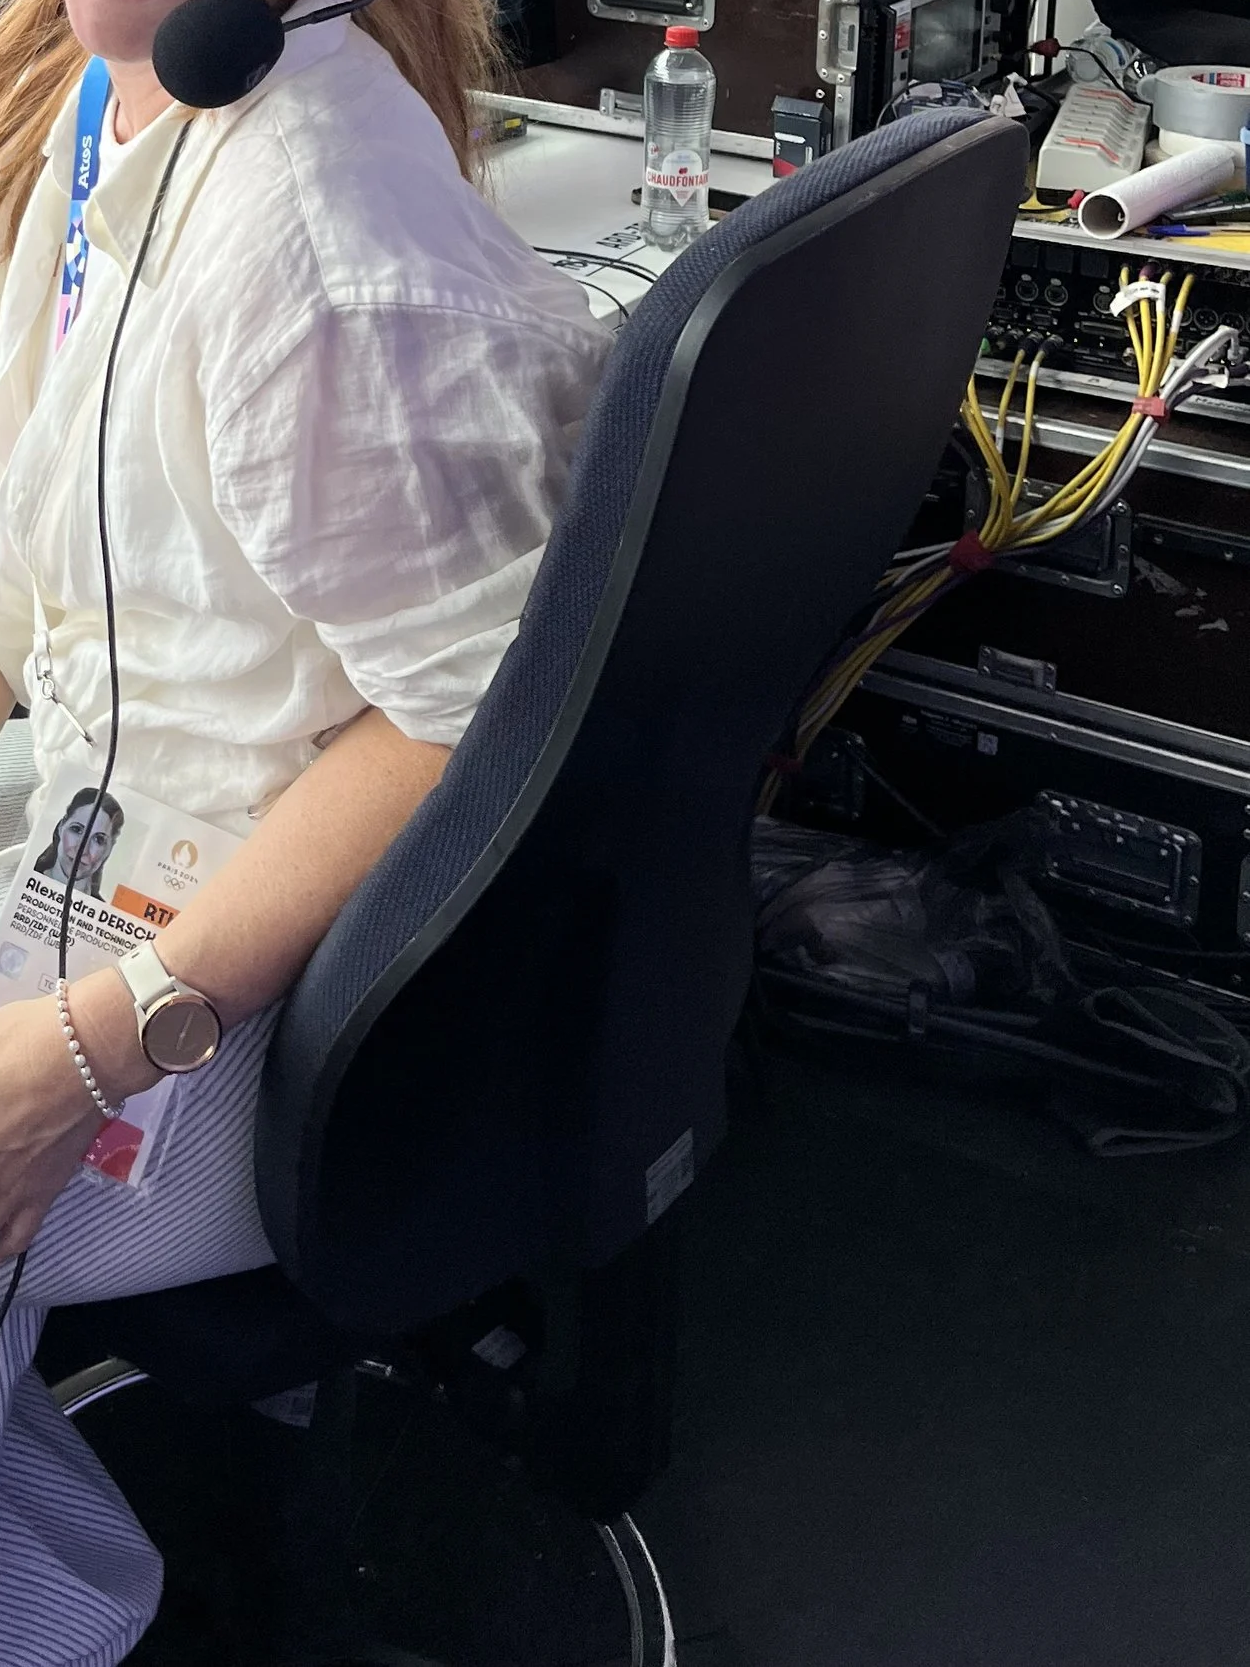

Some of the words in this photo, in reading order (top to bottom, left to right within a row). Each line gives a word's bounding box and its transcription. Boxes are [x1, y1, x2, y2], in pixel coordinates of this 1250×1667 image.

[157, 861, 178, 875] PARIS
[179, 871, 199, 885] 2024
[25, 877, 100, 918] Alexadra
[13, 912, 50, 934] ARD/ZDF
[77, 919, 94, 932] AND
